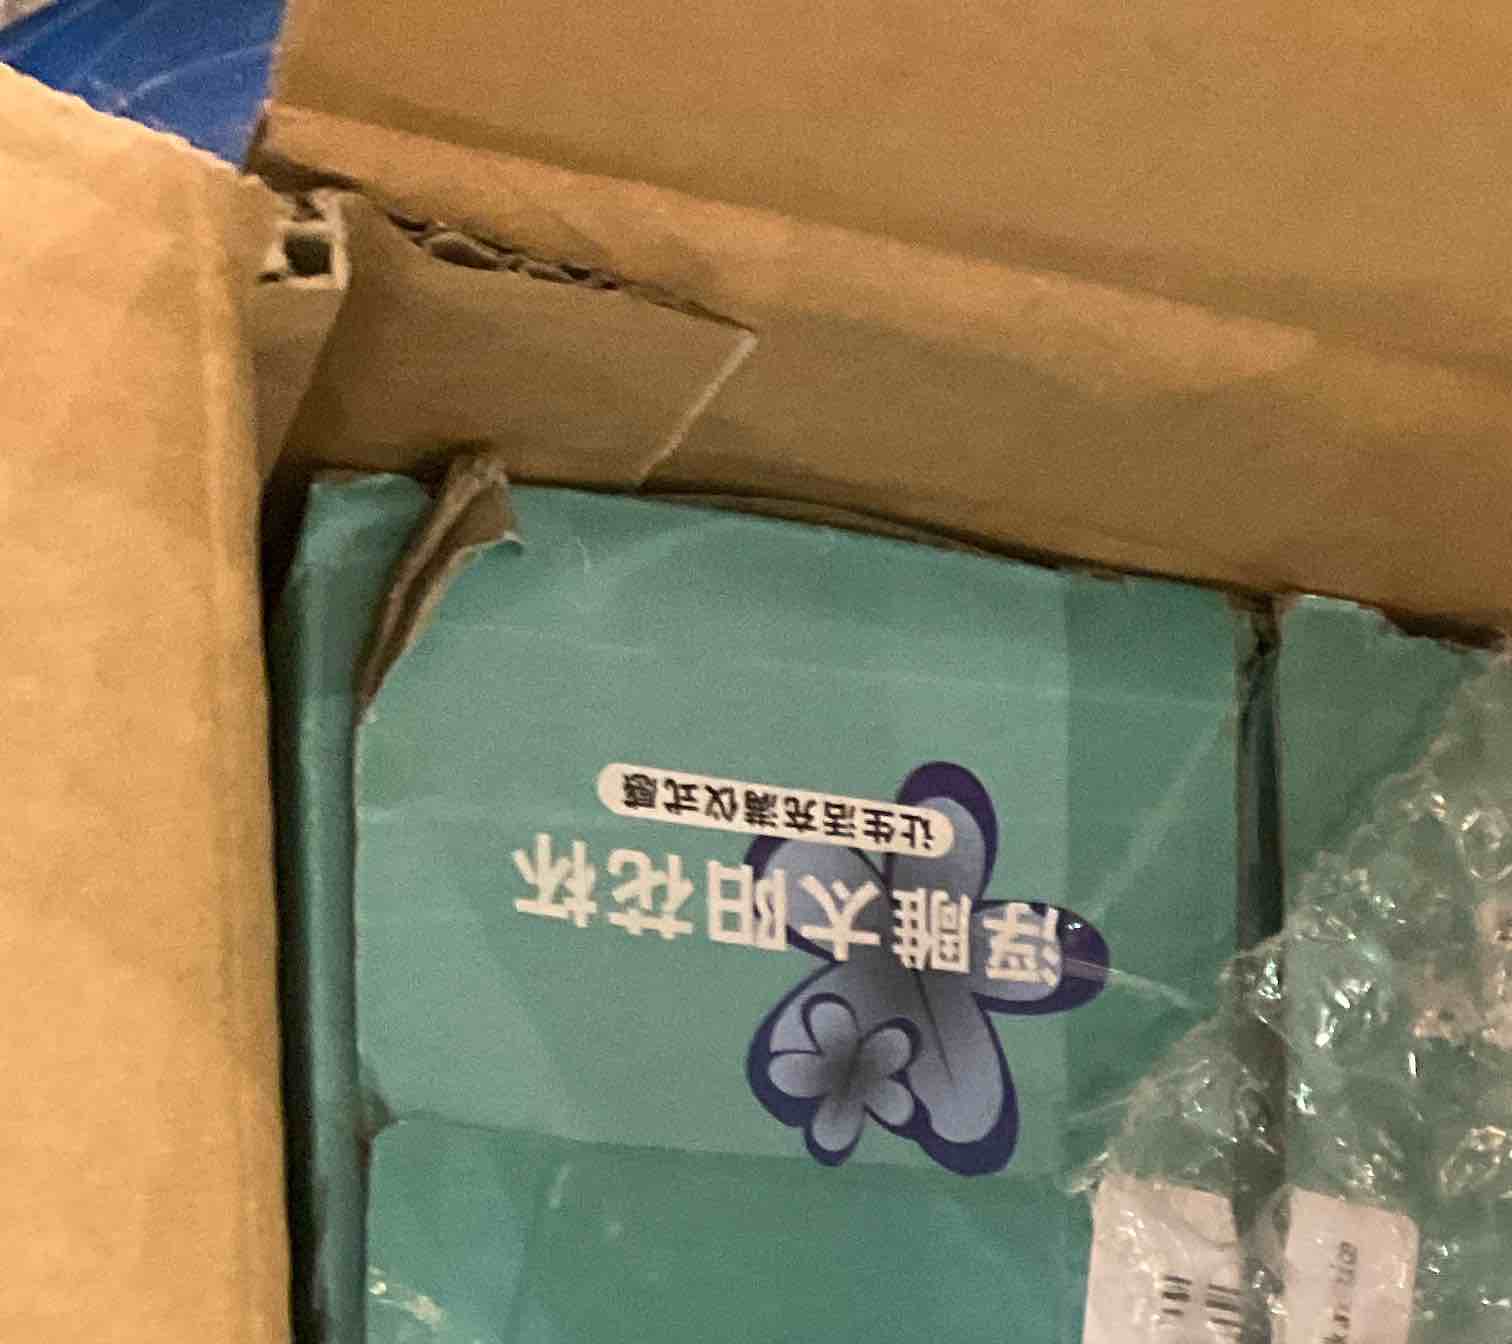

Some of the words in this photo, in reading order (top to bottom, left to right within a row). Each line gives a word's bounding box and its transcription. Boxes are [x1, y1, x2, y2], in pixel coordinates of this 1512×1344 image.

[622, 772, 935, 850] 让生活充满仪式感
[514, 832, 1062, 989] 浮雕太阳花杯
